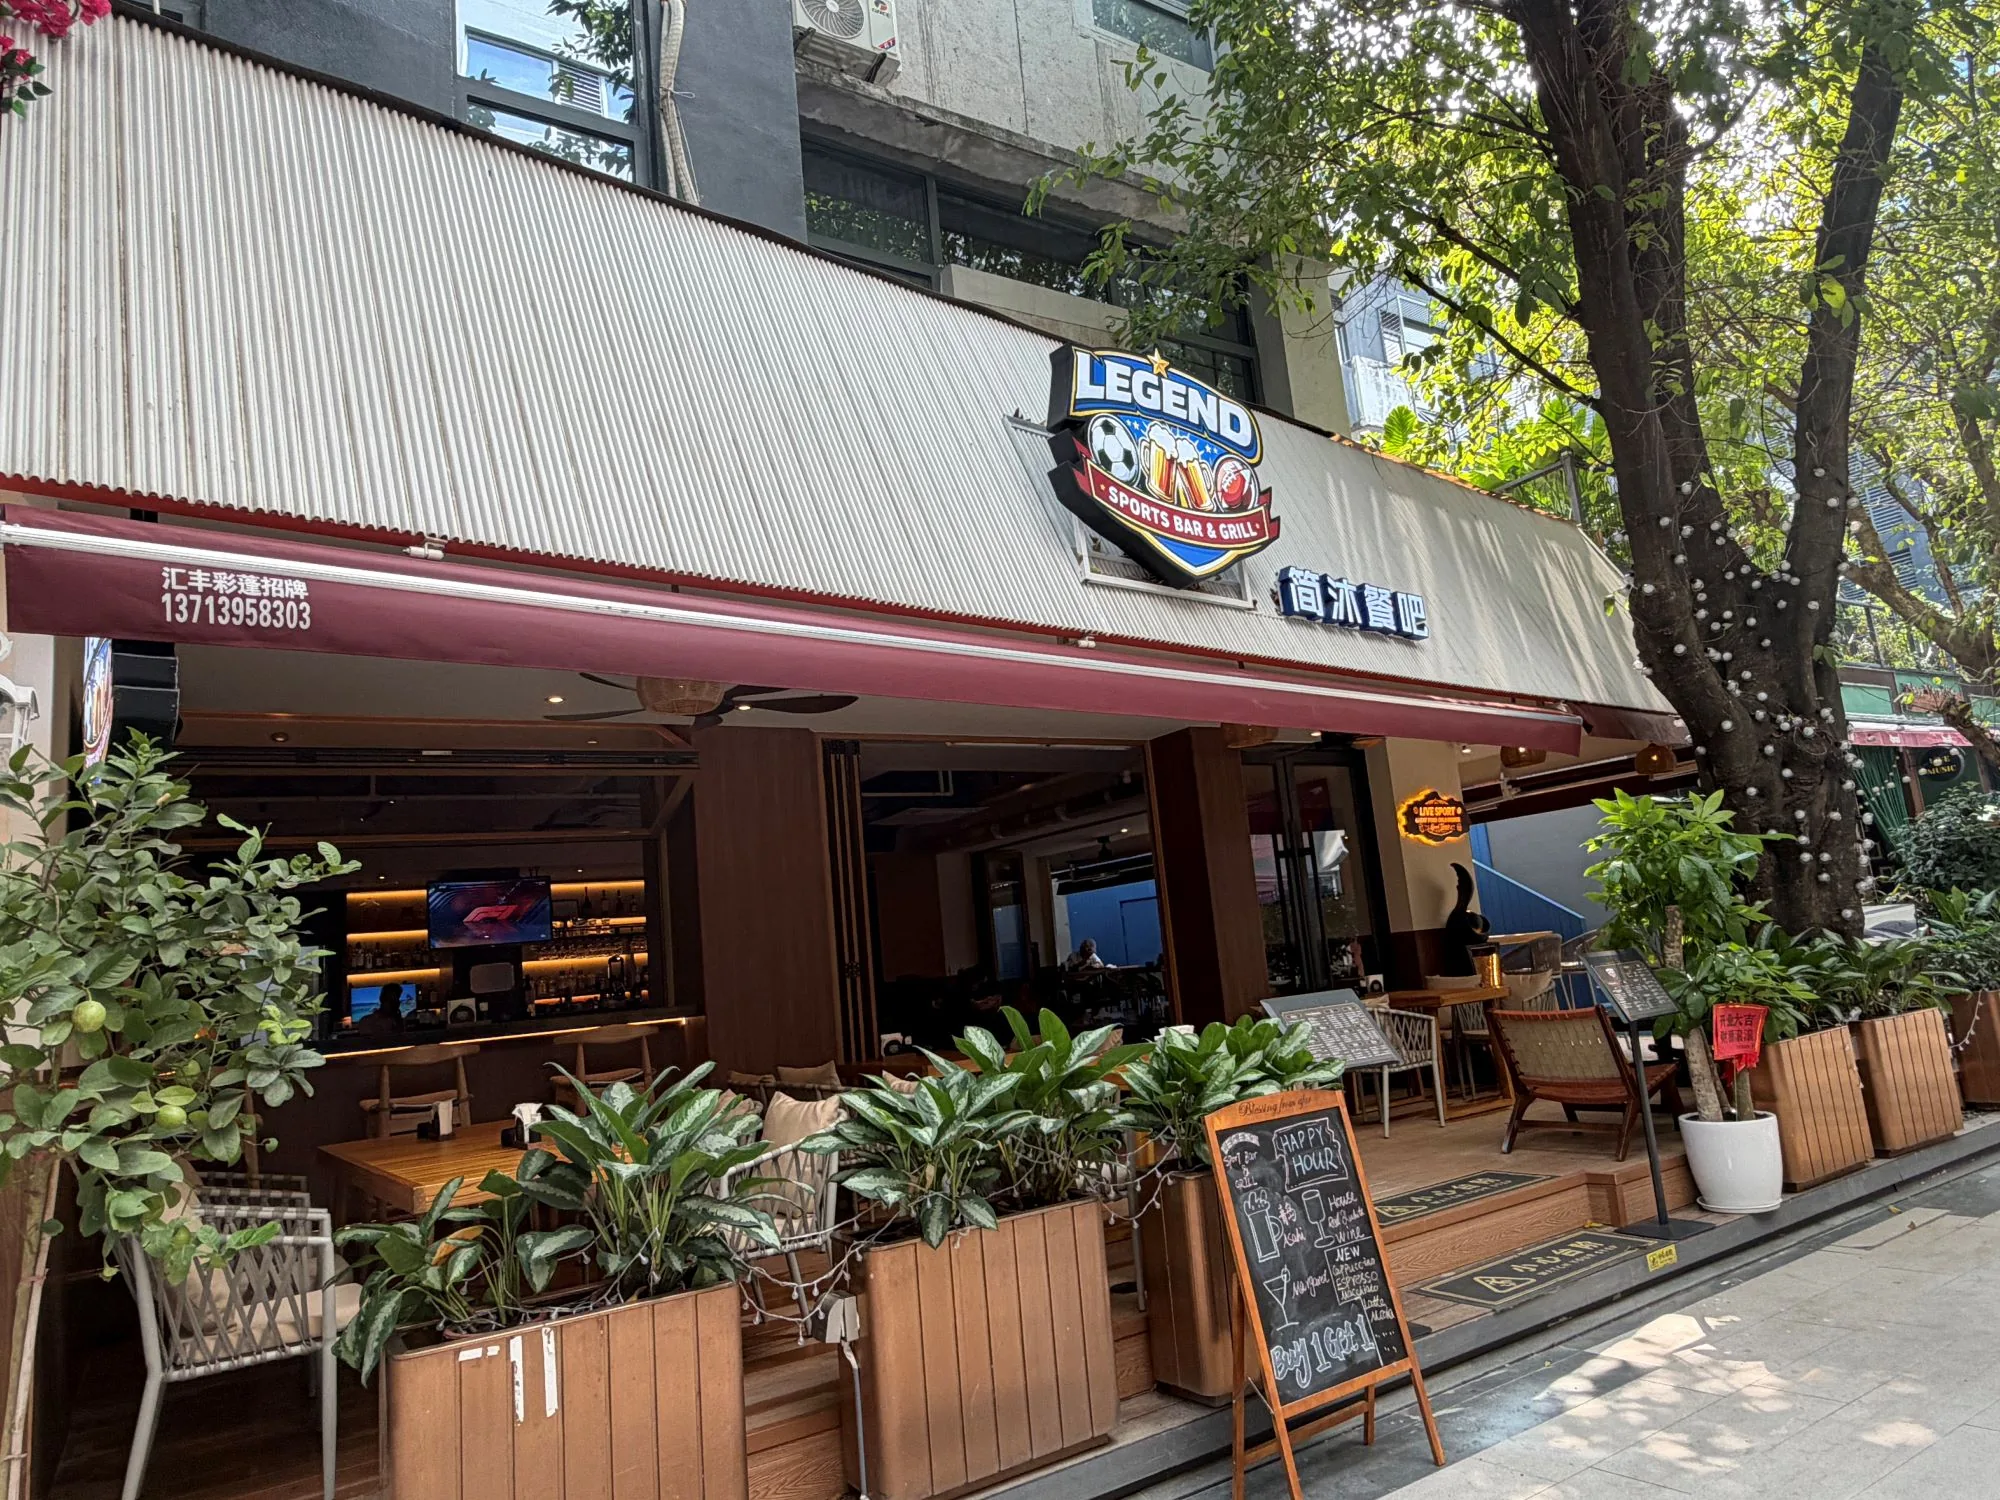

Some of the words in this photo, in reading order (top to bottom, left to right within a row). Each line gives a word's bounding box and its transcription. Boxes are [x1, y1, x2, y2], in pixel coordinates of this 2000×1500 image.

[1076, 349, 1252, 448] LEGEND
[1108, 485, 1170, 528] SPORTS
[1173, 515, 1204, 537] BAR
[1206, 523, 1217, 539] &
[1219, 521, 1258, 540] GRILL
[161, 592, 311, 630] 13713958303
[1927, 764, 1957, 775] MUSIC
[1419, 806, 1434, 817] LIVE
[1435, 806, 1456, 817] SPORT
[1279, 1125, 1325, 1155] HAPPY
[1292, 1147, 1338, 1177] HOUR
[1336, 1245, 1360, 1262] NEW
[1271, 1337, 1312, 1389] Buy
[1311, 1331, 1331, 1373] 1
[1324, 1320, 1359, 1360] Get
[1355, 1313, 1375, 1353] 1
